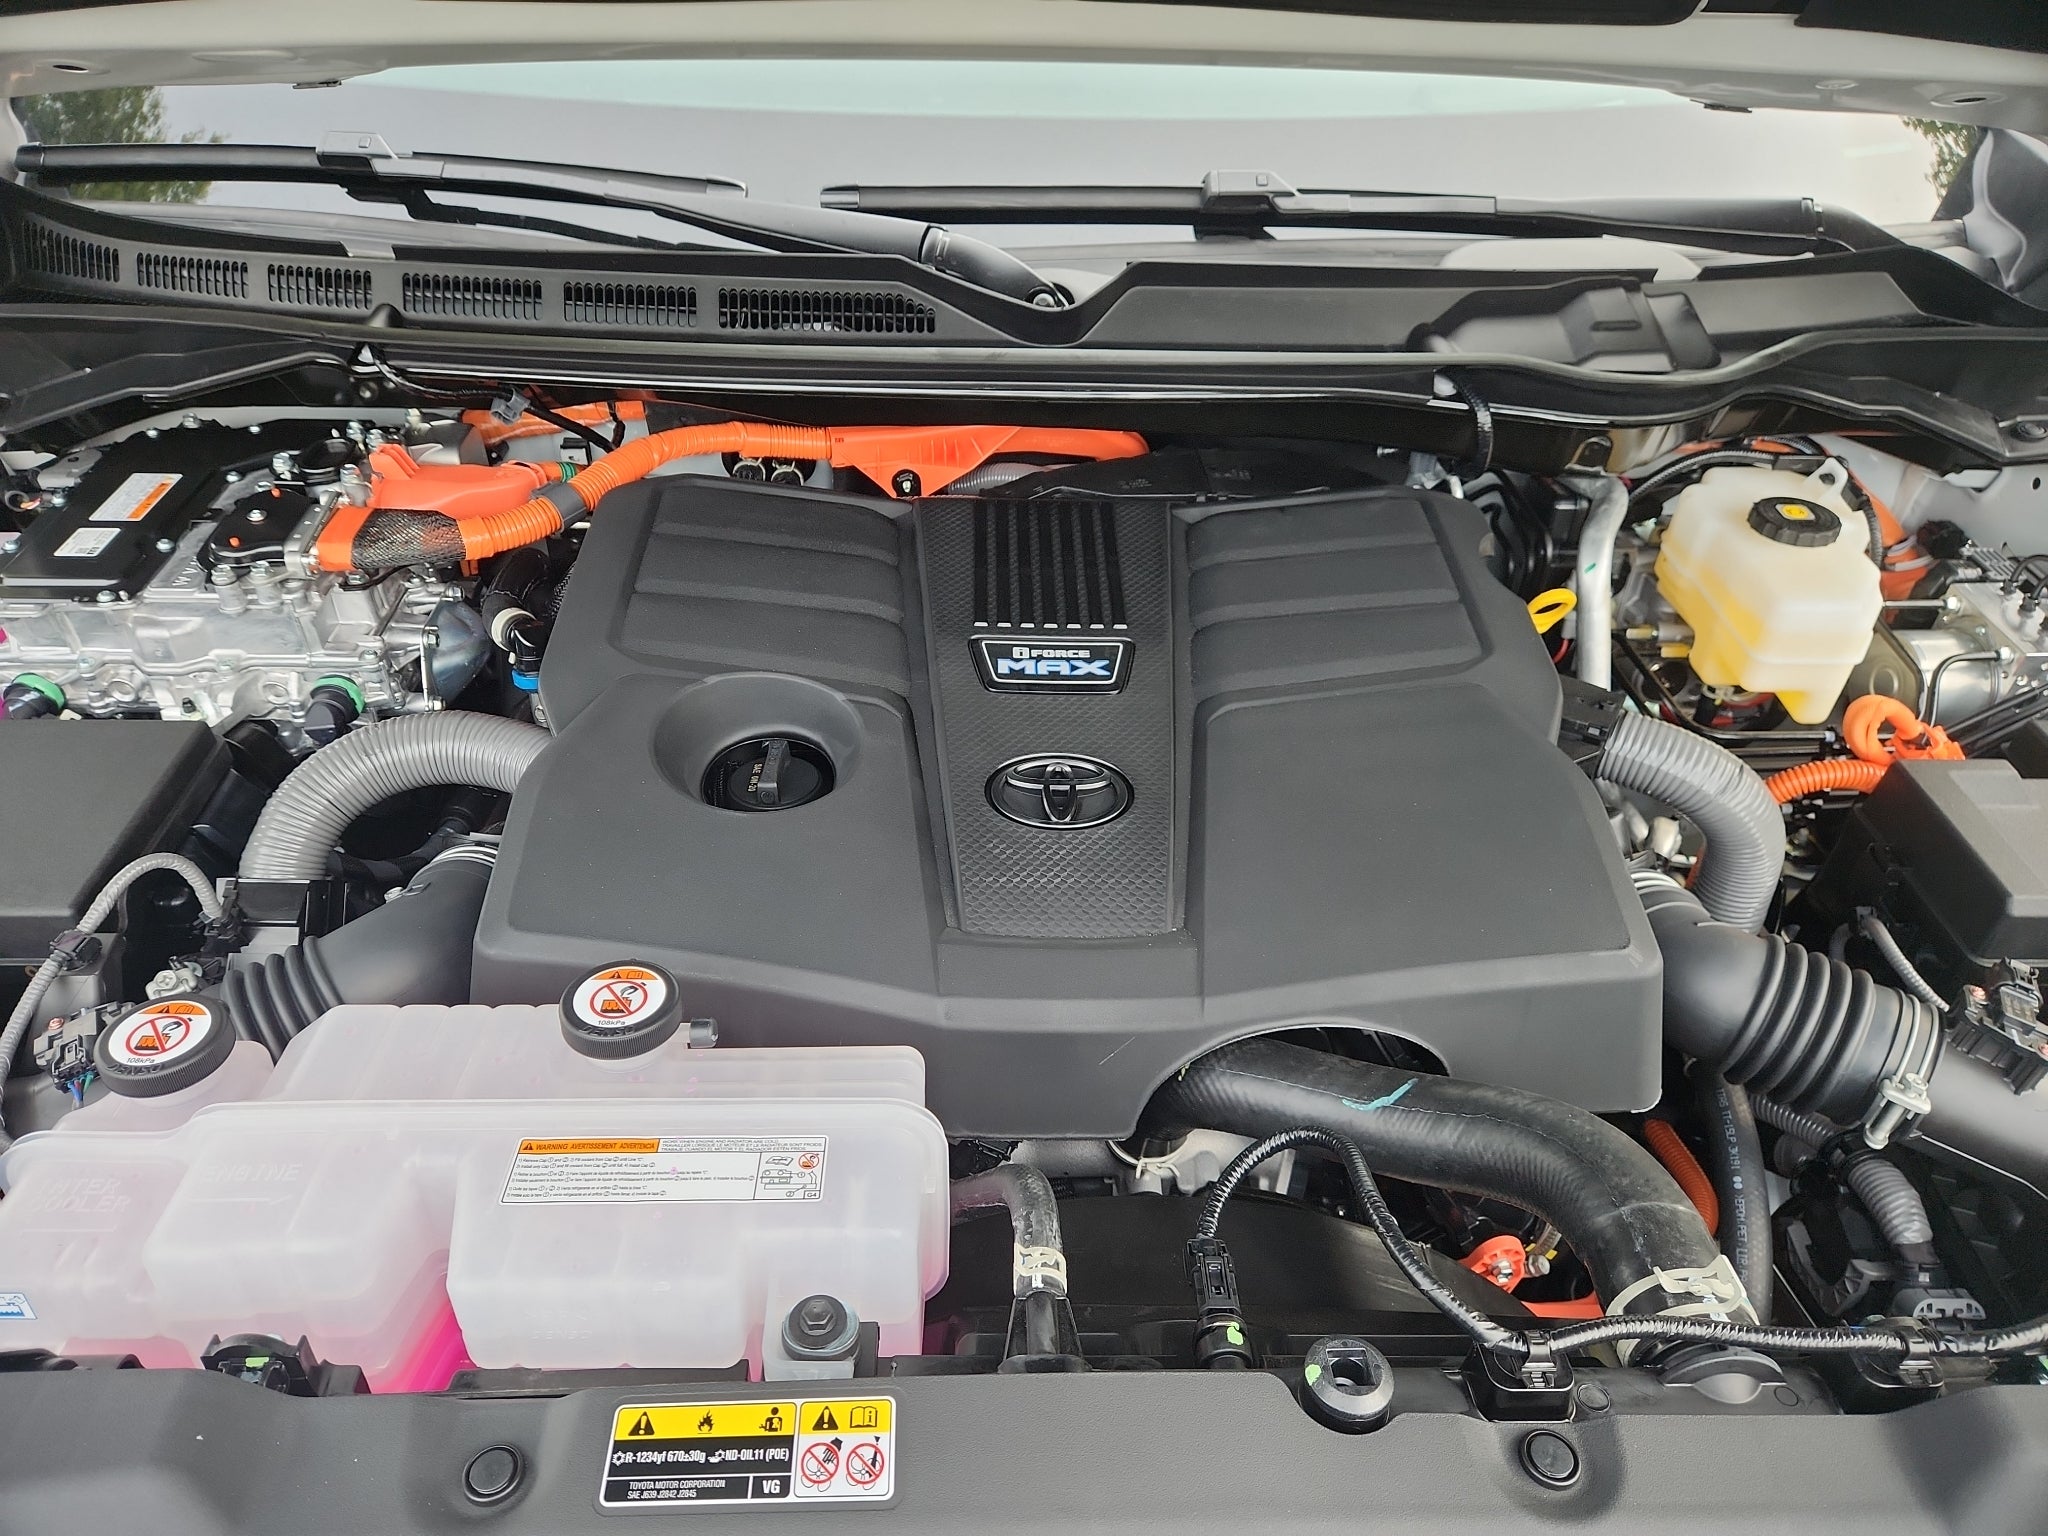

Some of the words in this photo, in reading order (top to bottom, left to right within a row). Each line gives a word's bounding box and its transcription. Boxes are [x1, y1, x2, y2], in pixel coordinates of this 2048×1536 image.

[997, 658, 1111, 676] MAX
[536, 1143, 568, 1151] WARNING
[570, 1142, 617, 1150] AVERTISSEMENT
[625, 1451, 666, 1465] R-1234yf
[667, 1450, 706, 1464] 670±30g
[725, 1449, 764, 1461] ND-OIL11
[765, 1448, 789, 1462] (POE)
[629, 1481, 654, 1490] TOYOTA
[655, 1480, 679, 1489] MOTOR
[679, 1479, 726, 1489] CORPORATION
[762, 1479, 781, 1494] VG
[627, 1490, 640, 1499] SAE
[641, 1490, 657, 1499] J639
